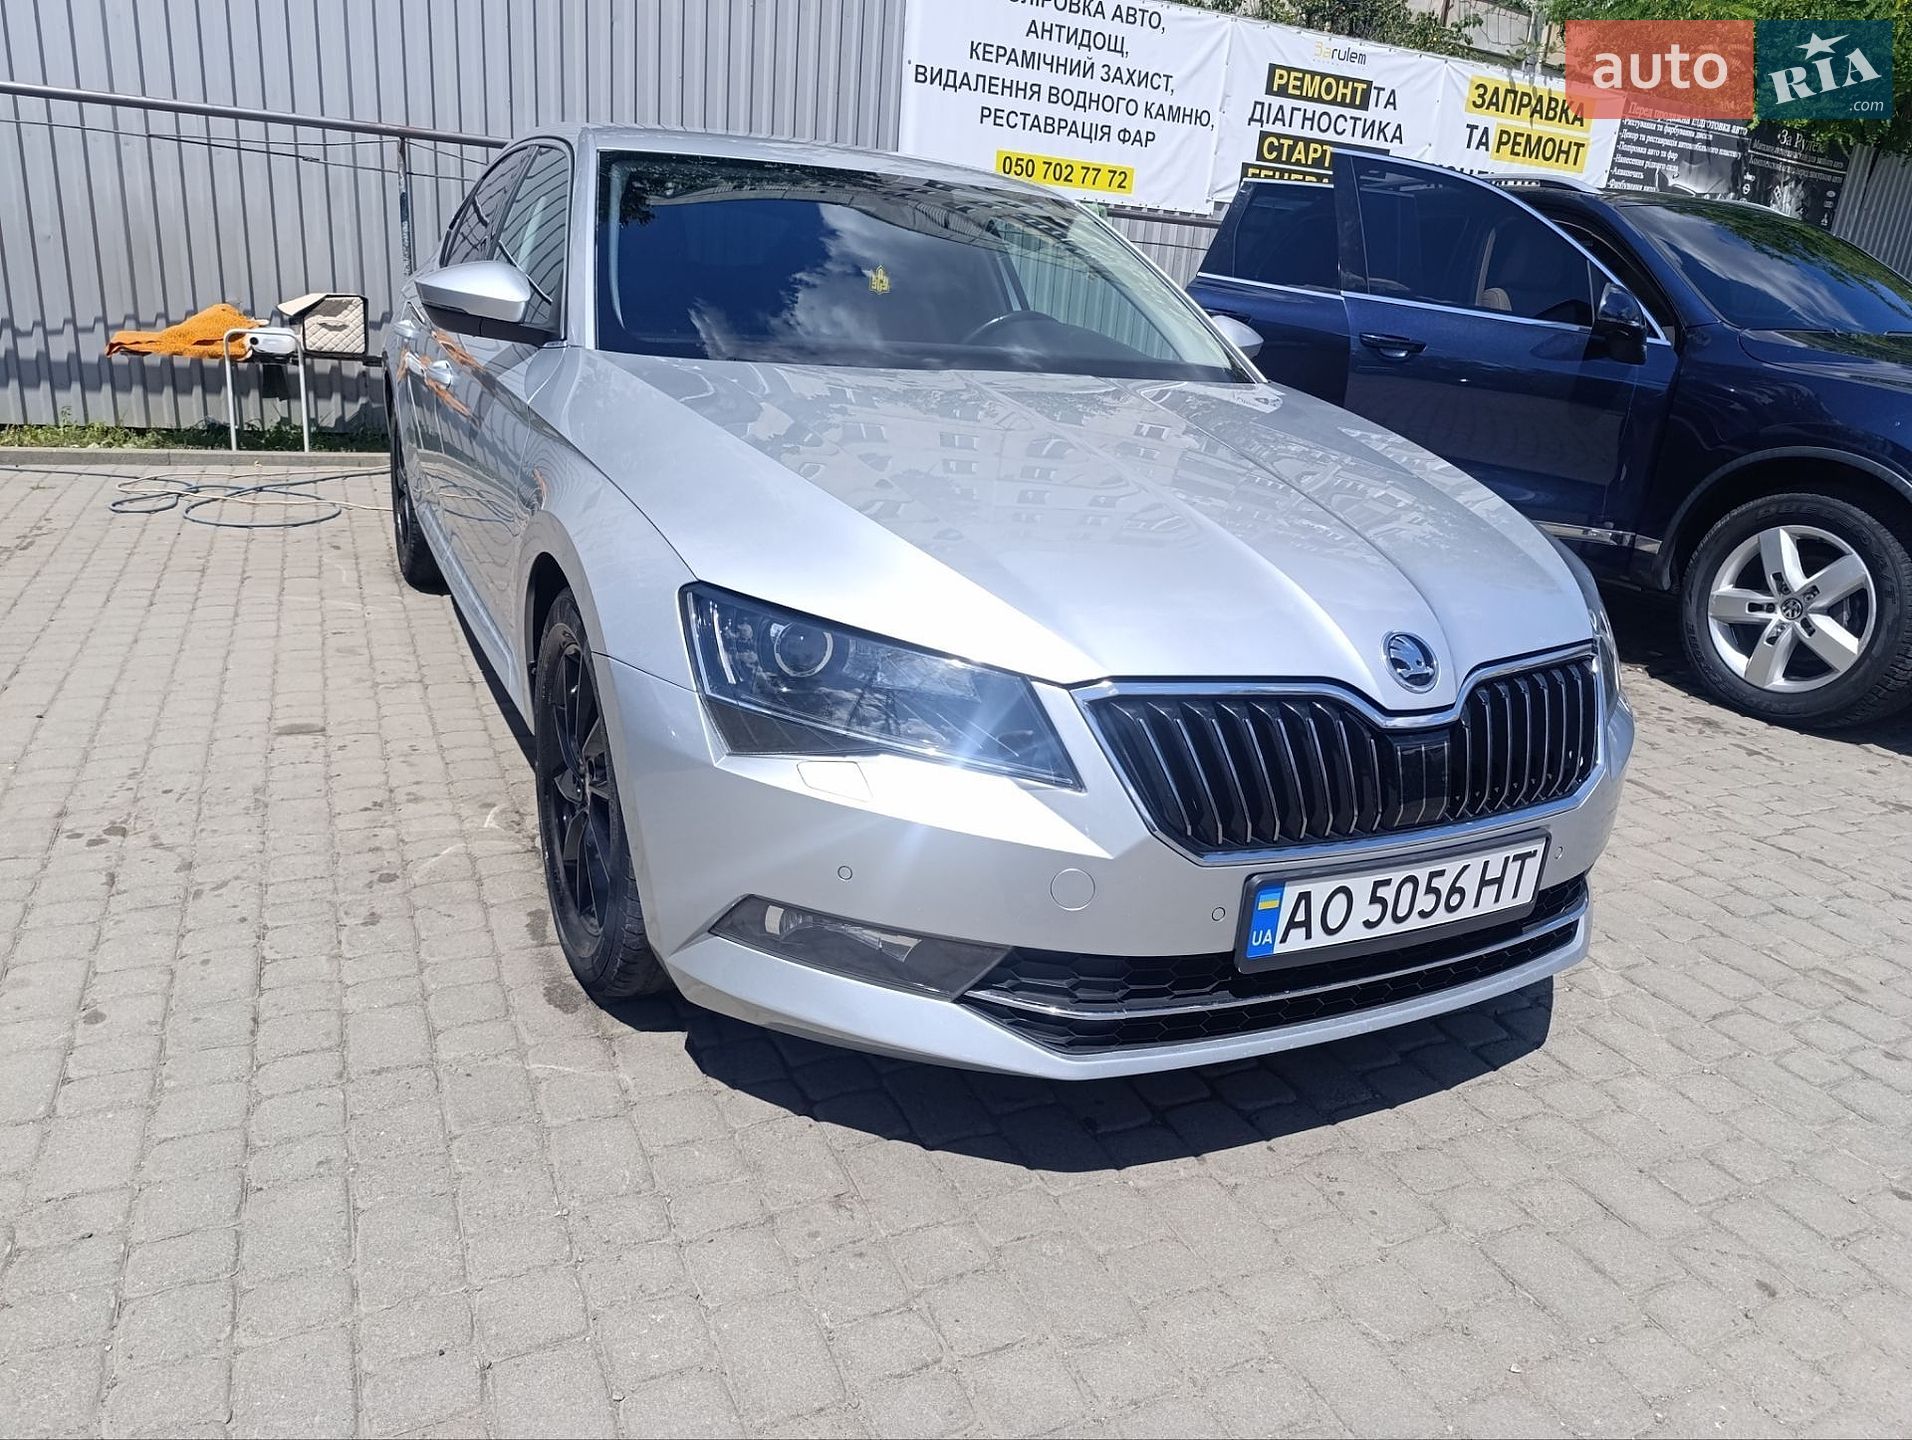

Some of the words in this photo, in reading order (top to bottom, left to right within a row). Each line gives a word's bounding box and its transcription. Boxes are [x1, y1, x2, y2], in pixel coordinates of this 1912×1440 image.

[1025, 19, 1129, 58] АНТИДОЩ,
[1111, 4, 1166, 33] АВТО,
[969, 41, 1095, 80] КЕРАМІЧНИЙ
[1100, 64, 1175, 95] ЗАХИСТ,
[1272, 68, 1368, 105] РЕМОНТ
[1373, 86, 1398, 110] ТА
[914, 64, 1041, 103] ВИДАЛЕННЯ
[1048, 86, 1139, 117] ВОДНОГО
[1144, 102, 1215, 131] КАМНЮ,
[1472, 83, 1584, 127] ЗАПРАВКА
[980, 106, 1112, 144] РЕСТАВРАЦІЯ
[1117, 126, 1156, 149] ФАР
[1248, 101, 1403, 144] ДІАГНОСТИКА
[1262, 136, 1333, 167] СТАРТ
[1466, 123, 1489, 151] ТА
[1495, 129, 1586, 166] РЕМОНТ
[1002, 155, 1035, 177] 050
[1042, 161, 1073, 183] 702
[1080, 166, 1102, 186] 77
[1108, 169, 1128, 189] 72
[1279, 885, 1354, 944] AO
[1362, 864, 1471, 929] 5056
[1251, 929, 1273, 947] UA
